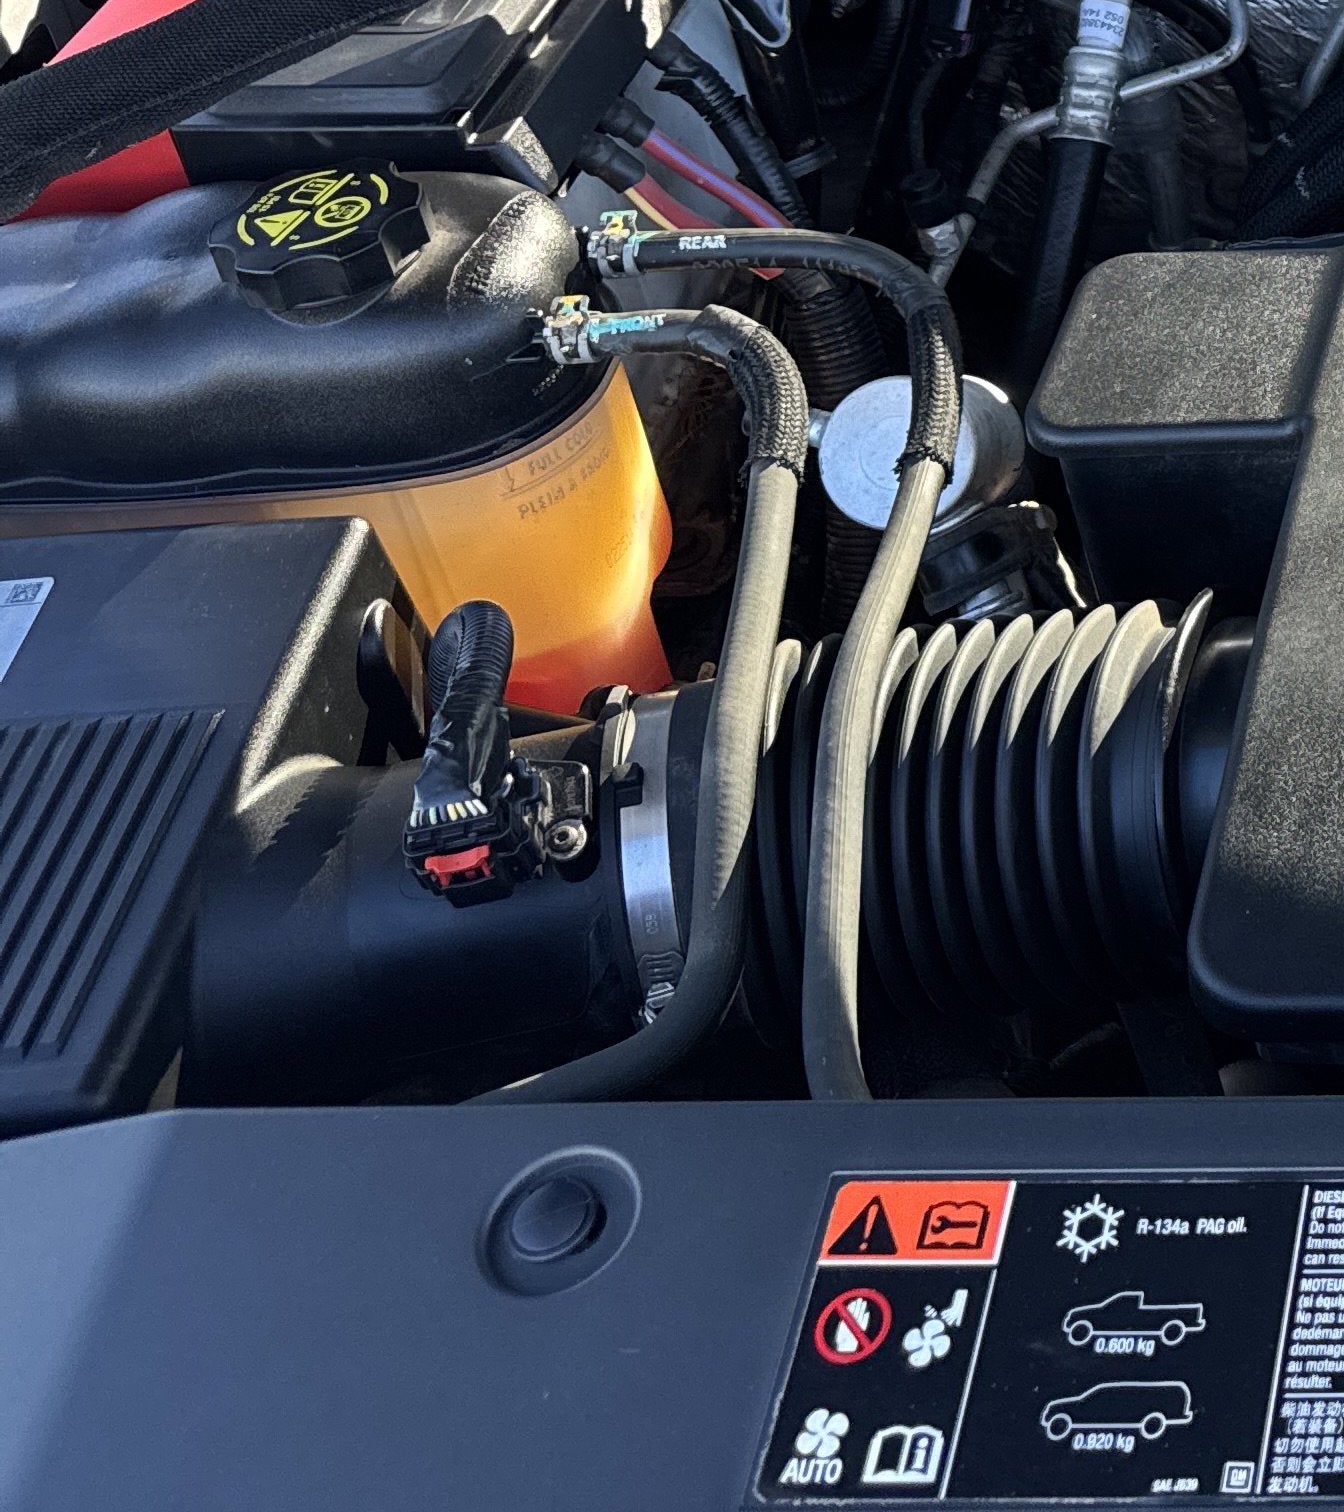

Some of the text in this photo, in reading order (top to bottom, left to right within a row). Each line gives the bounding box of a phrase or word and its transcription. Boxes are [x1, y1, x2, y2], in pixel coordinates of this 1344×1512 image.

[678, 235, 727, 250] REAR
[1311, 1205, 1325, 1219] (If
[1136, 1217, 1248, 1235] R-134a PAG oil.
[1309, 1221, 1324, 1234] Do
[1303, 1253, 1325, 1265] can
[1298, 1294, 1313, 1309] (si
[1295, 1311, 1312, 1324] Ne
[1314, 1312, 1335, 1326] pas
[1094, 1338, 1155, 1356] 0.600 kg
[1287, 1360, 1303, 1373] au
[1284, 1374, 1333, 1389] résulter.
[1116, 1432, 1136, 1453] kg
[777, 1457, 844, 1484] AUTO
